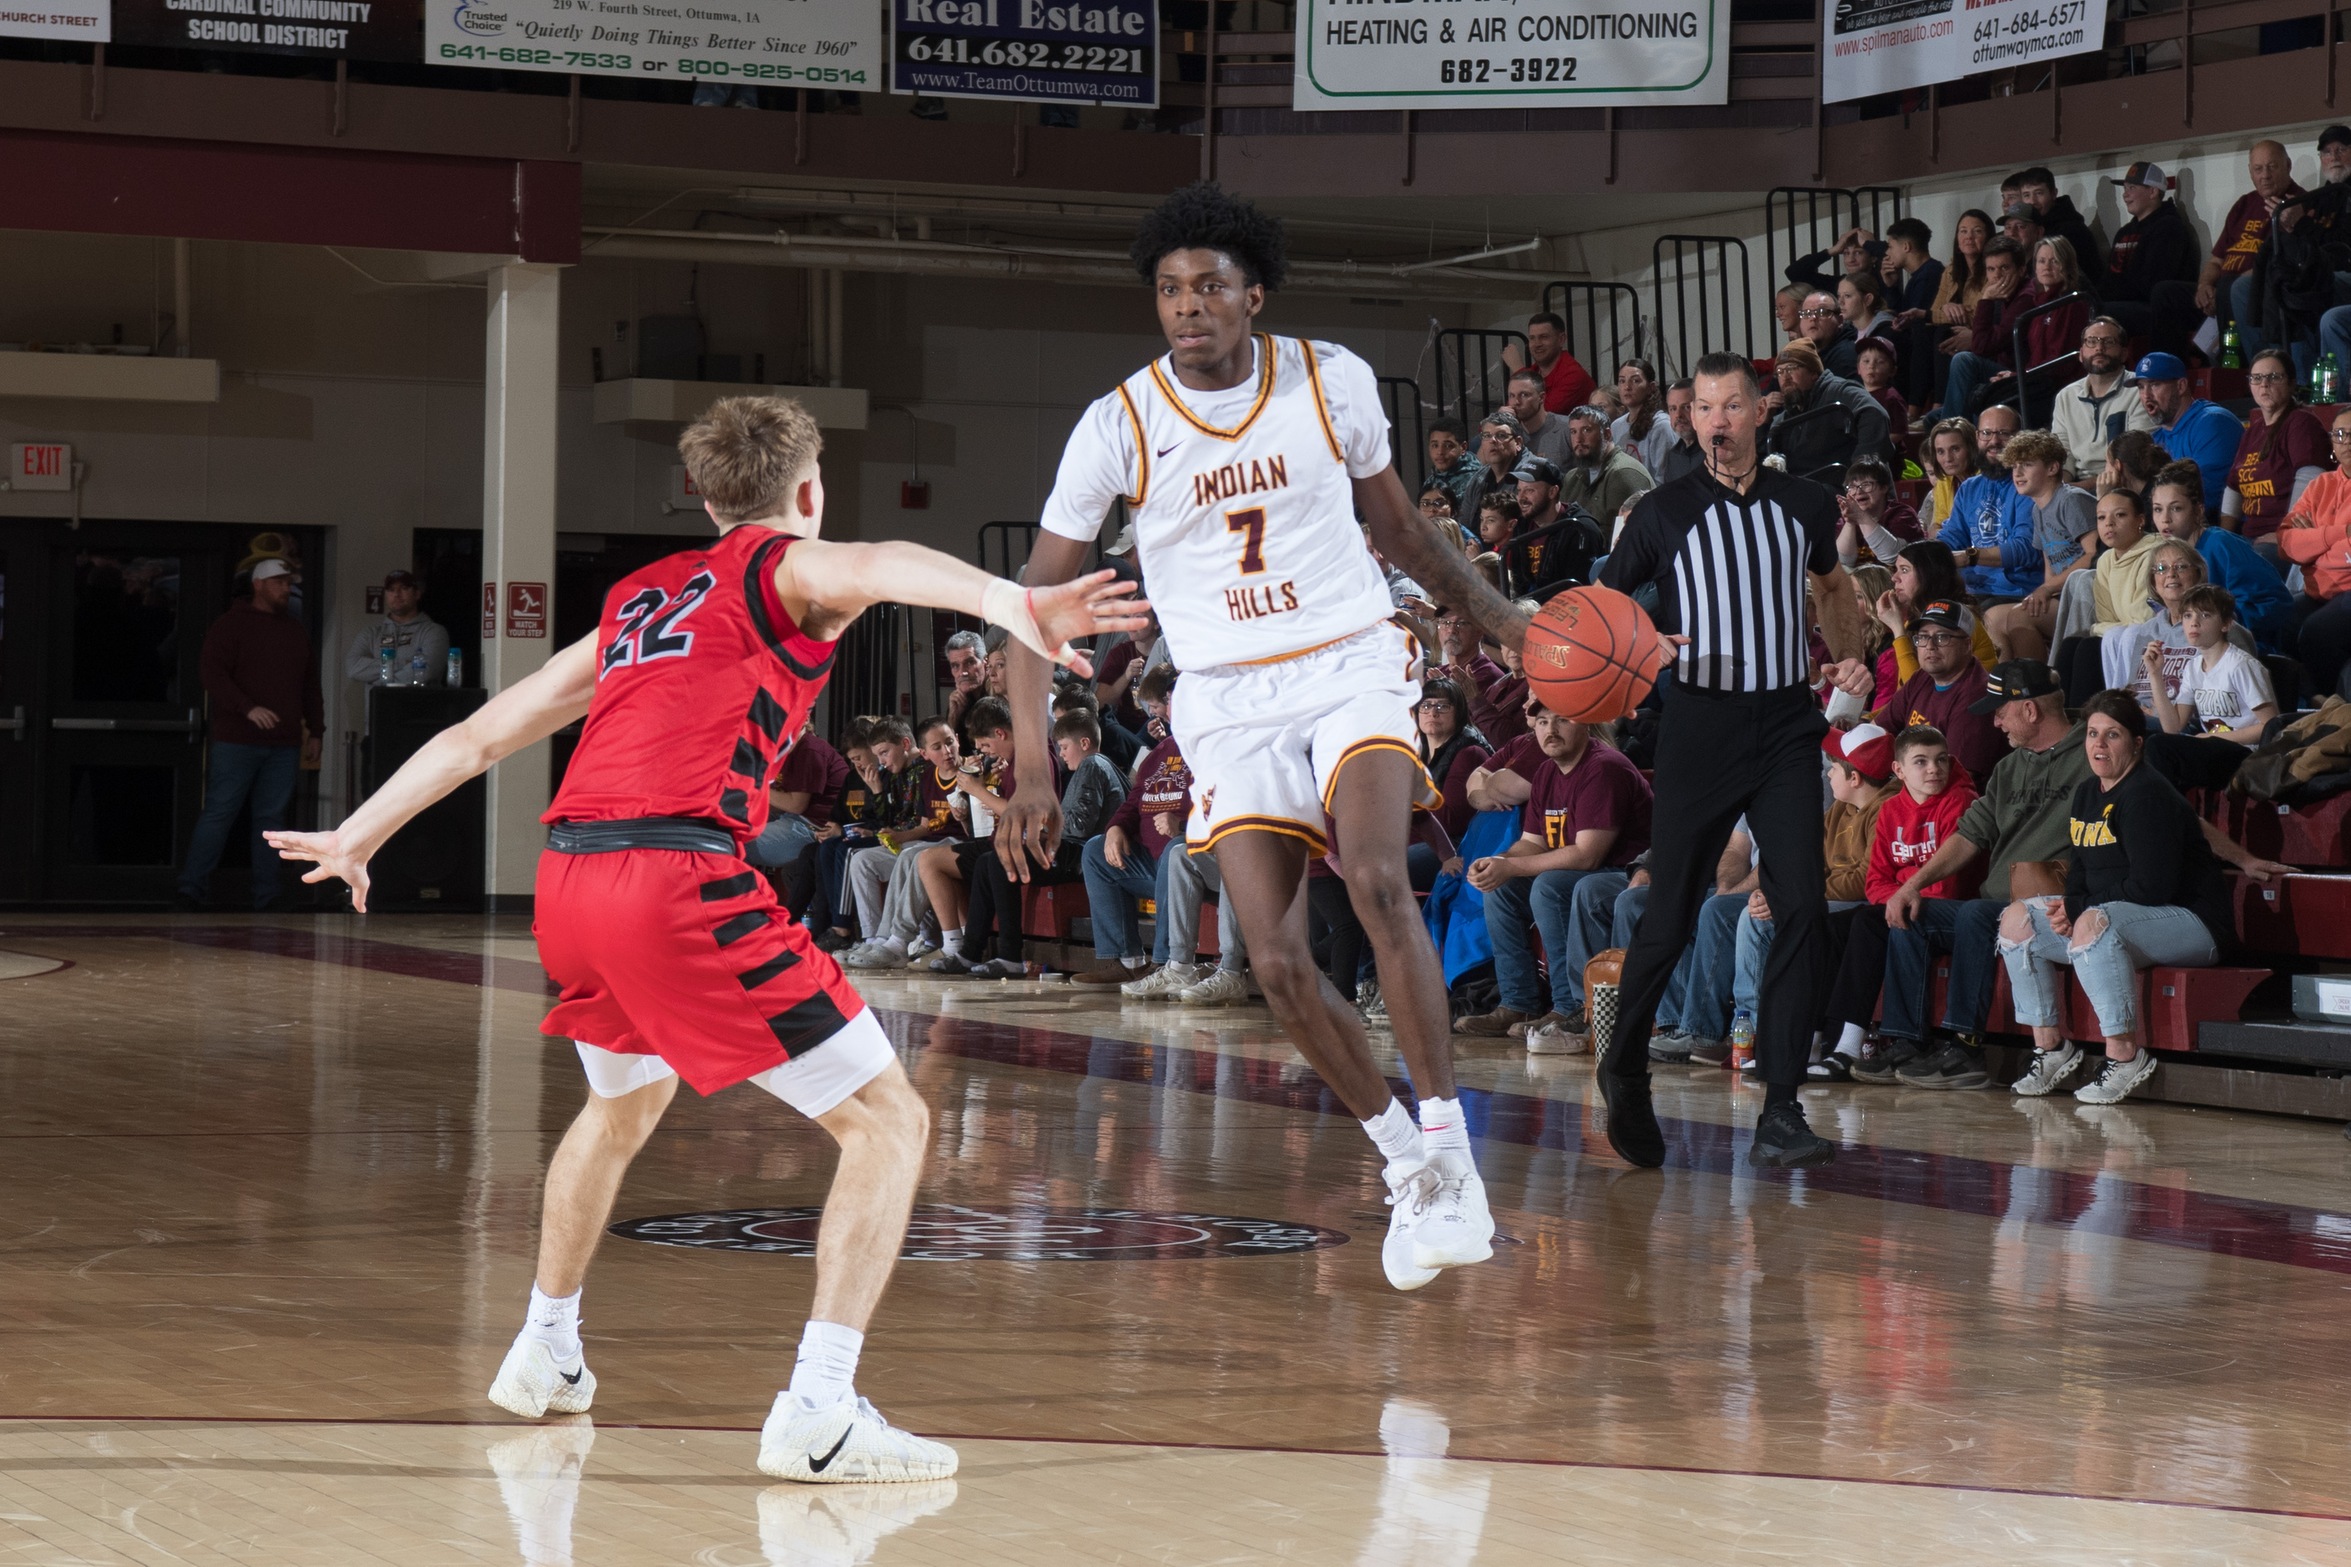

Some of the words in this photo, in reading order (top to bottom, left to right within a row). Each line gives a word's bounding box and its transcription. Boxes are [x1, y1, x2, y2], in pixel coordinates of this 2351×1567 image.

[0, 11, 46, 24] HURCH
[51, 15, 98, 26] STREET
[260, 0, 371, 23] COMMUNITY
[464, 20, 501, 31] Choice
[465, 11, 507, 21] Trusted
[553, 0, 572, 10] 219
[577, 0, 594, 12] W.
[599, 2, 638, 15] Fourth
[642, 5, 681, 18] Street,
[686, 8, 742, 23] Ottumwa,
[746, 13, 760, 23] IA
[906, 0, 999, 26] Real
[1019, 0, 1145, 35] Estate
[1973, 1, 2086, 42] 641-684-6571
[188, 19, 260, 43] SCHOOL
[264, 24, 349, 49] DISTRICT
[592, 25, 640, 45] Doing
[648, 29, 699, 48] Things
[707, 33, 756, 50] Better
[763, 37, 806, 54] Since
[1327, 20, 1428, 45] HEATING
[1440, 19, 1456, 43] &
[1468, 17, 1507, 43] AIR
[1518, 12, 1698, 41] CONDITIONING
[1834, 18, 1954, 57] www.spilmanauto.com
[908, 36, 1143, 73] 641.682.2221
[1972, 28, 2084, 64] ottumwaymca.com
[440, 44, 632, 69] 641-682-7533
[643, 60, 668, 71] or
[678, 59, 867, 84] 800-925-0514
[1441, 57, 1577, 83] 682-3922
[912, 72, 1140, 98] www.TeamOttumwa.com
[24, 446, 62, 475] EXIT
[1194, 455, 1288, 507] INDIAN
[1225, 505, 1267, 576] 7
[371, 597, 380, 612] 4
[1225, 580, 1299, 621] HILLS
[508, 629, 527, 637] YOUR
[527, 629, 543, 637] STEP
[514, 621, 537, 629] WATCH
[600, 569, 717, 682] 22
